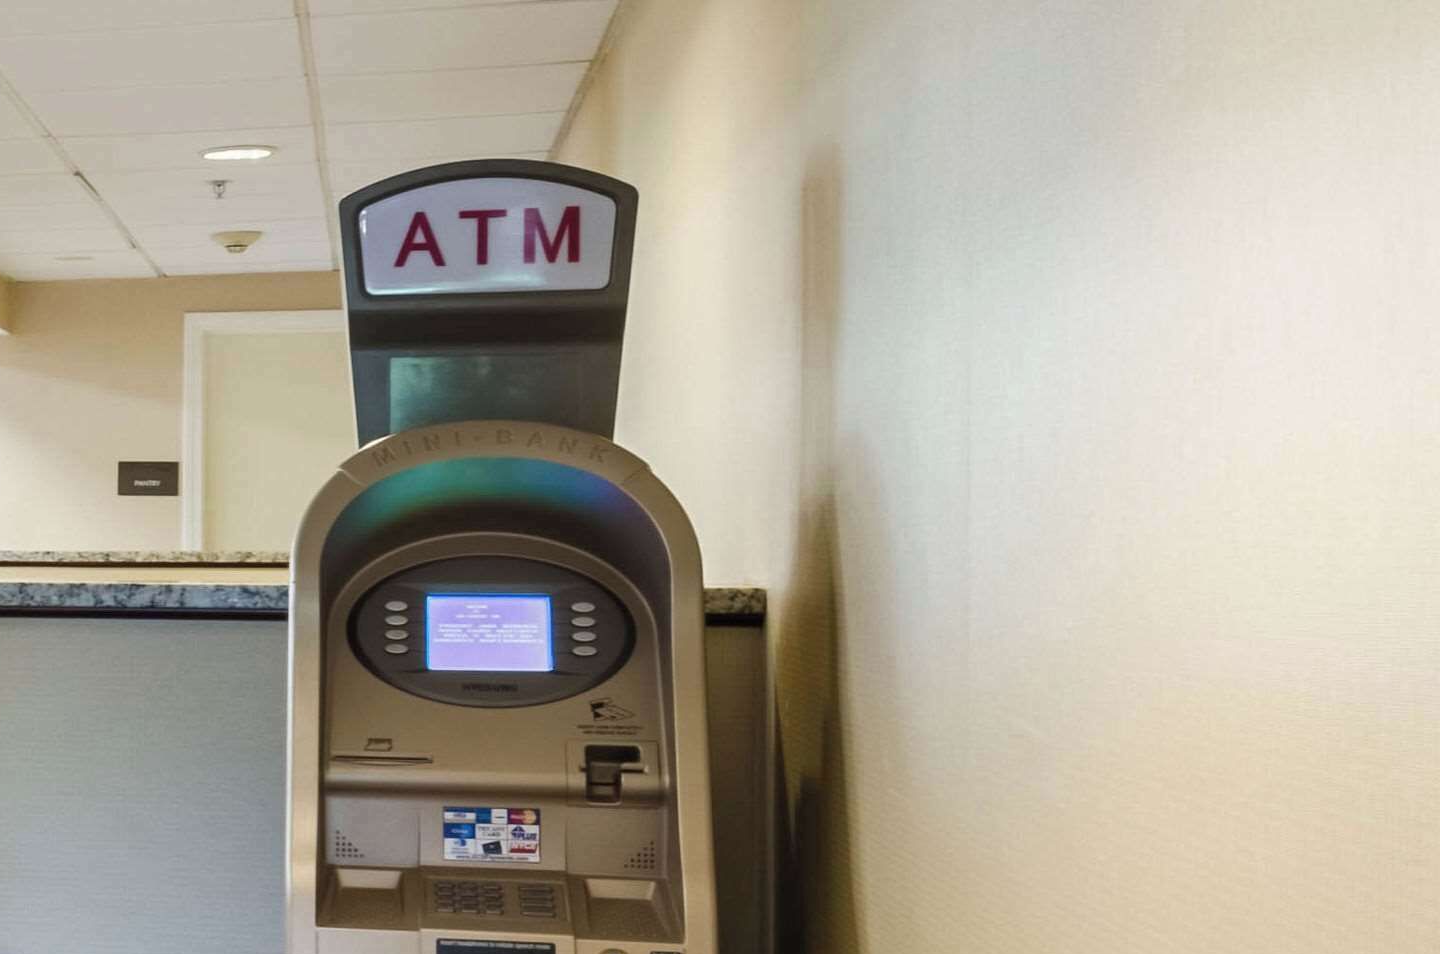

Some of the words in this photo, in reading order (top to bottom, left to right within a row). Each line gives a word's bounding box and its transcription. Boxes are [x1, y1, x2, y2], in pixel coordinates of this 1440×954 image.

[393, 205, 581, 268] ATM
[371, 428, 607, 468] MINI-BANK
[133, 479, 161, 487] PANTRY
